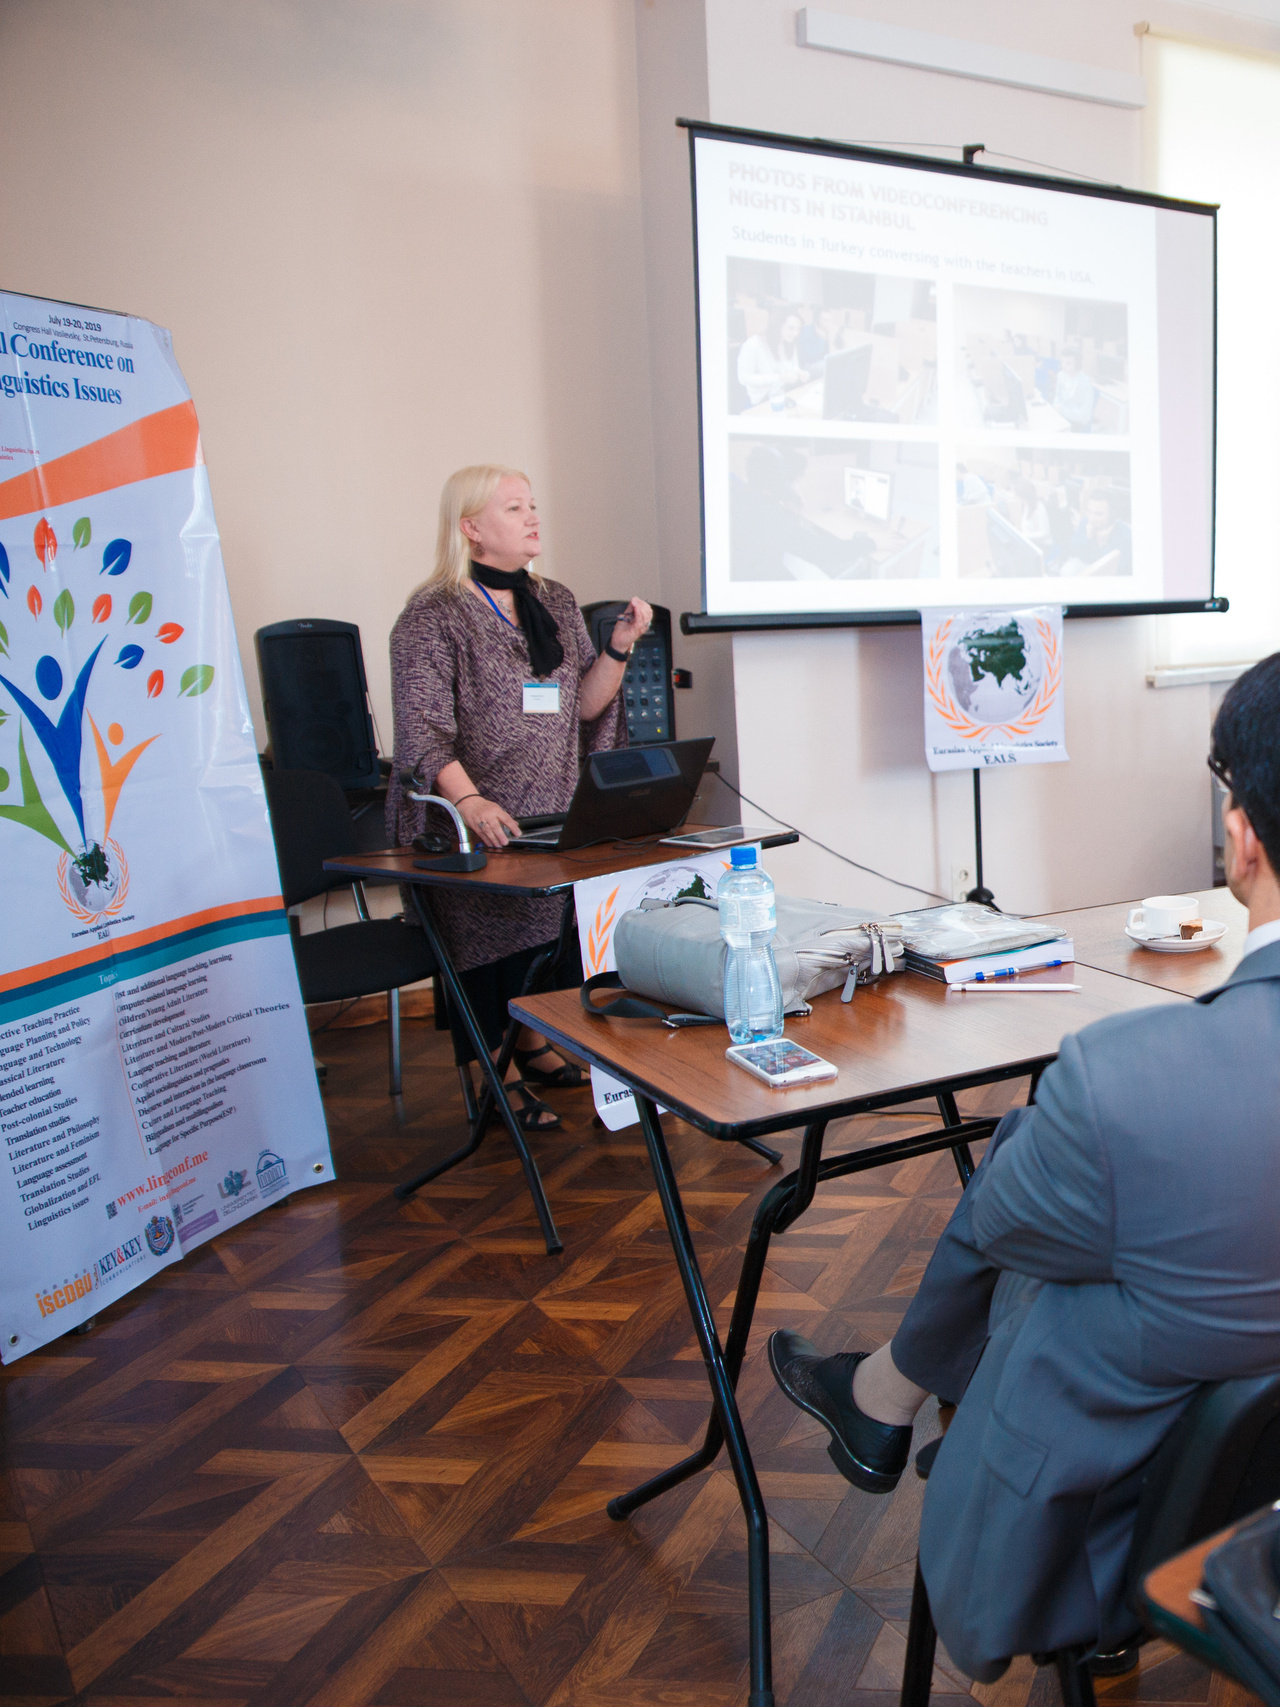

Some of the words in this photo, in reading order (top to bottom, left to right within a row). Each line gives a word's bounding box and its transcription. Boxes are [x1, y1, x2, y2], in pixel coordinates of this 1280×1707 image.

[728, 160, 807, 190] PHOTOS
[812, 174, 865, 200] FROM
[868, 182, 1049, 227] VIDEOCONFERENCING
[728, 187, 801, 215] NIGHTS
[806, 200, 826, 218] IN
[831, 203, 916, 231] ISTANBUL
[732, 225, 797, 247] Students
[802, 235, 815, 249] in
[819, 236, 865, 259] Turkey
[868, 245, 940, 268] conversing
[944, 254, 973, 270] with
[975, 257, 996, 272] the
[1000, 260, 1052, 280] teachers
[1055, 267, 1066, 282] in
[13, 322, 41, 334] Congress
[49, 315, 62, 327] July
[62, 318, 84, 330] 19-20,
[85, 321, 102, 332] 2019
[10, 333, 113, 370] Conference
[117, 356, 135, 374] on
[72, 377, 122, 404] Issues
[983, 753, 1017, 765] EALS
[127, 985, 140, 996] and
[140, 976, 166, 991] additional
[166, 969, 187, 982] language
[208, 954, 233, 965] learning
[165, 981, 188, 994] language
[187, 975, 208, 987] learning
[166, 998, 181, 1009] Adult
[181, 988, 208, 1003] Literature
[21, 1016, 53, 1033] Teaching
[53, 1006, 80, 1021] Practice
[26, 1030, 57, 1047] Planning
[57, 1025, 71, 1035] and
[71, 1017, 91, 1029] Policy
[121, 1036, 153, 1053] Literature
[154, 1030, 166, 1040] and
[166, 1021, 191, 1035] Cultural
[191, 1013, 211, 1025] Studies
[124, 1049, 156, 1066] Literature
[156, 1043, 168, 1053] and
[226, 1010, 253, 1023] Critical
[253, 1003, 290, 1015] Theories
[153, 1010, 186, 1026] development
[28, 1049, 44, 1061] and
[44, 1035, 82, 1054] Technology
[155, 1053, 178, 1067] teaching
[178, 1048, 189, 1058] and
[188, 1040, 211, 1053] literature
[169, 1058, 199, 1075] Literature
[217, 1036, 251, 1054] Literature)
[27, 1057, 65, 1076] Literature
[162, 1095, 173, 1106] and
[206, 1077, 215, 1086] the
[236, 1057, 267, 1072] classroom
[193, 1068, 204, 1078] and
[25, 1076, 55, 1093] learning
[28, 1089, 62, 1106] education
[1, 1106, 53, 1132] Post-colonial
[53, 1097, 78, 1112] Studies
[162, 1108, 174, 1119] and
[174, 1097, 202, 1114] Language
[202, 1085, 227, 1101] Teaching
[5, 1125, 48, 1146] Translation
[48, 1115, 71, 1129] studies
[9, 1139, 51, 1161] Literature
[52, 1131, 66, 1143] and
[67, 1116, 100, 1137] Philosophy
[171, 1134, 180, 1143] for
[175, 1116, 186, 1127] and
[12, 1152, 54, 1175] Literature
[56, 1145, 70, 1157] and
[70, 1131, 100, 1150] Feminism
[16, 1167, 54, 1189] Language
[54, 1152, 88, 1173] assessment
[20, 1178, 66, 1203] Translation
[67, 1166, 90, 1182] Studies
[117, 1151, 208, 1207] www.lingconf.me
[24, 1188, 77, 1217] Globalization
[77, 1180, 89, 1193] and
[88, 1173, 101, 1186] EFL
[28, 1206, 72, 1231] Linguistics
[72, 1196, 90, 1210] issues
[98, 1235, 143, 1276] KEY&KEY
